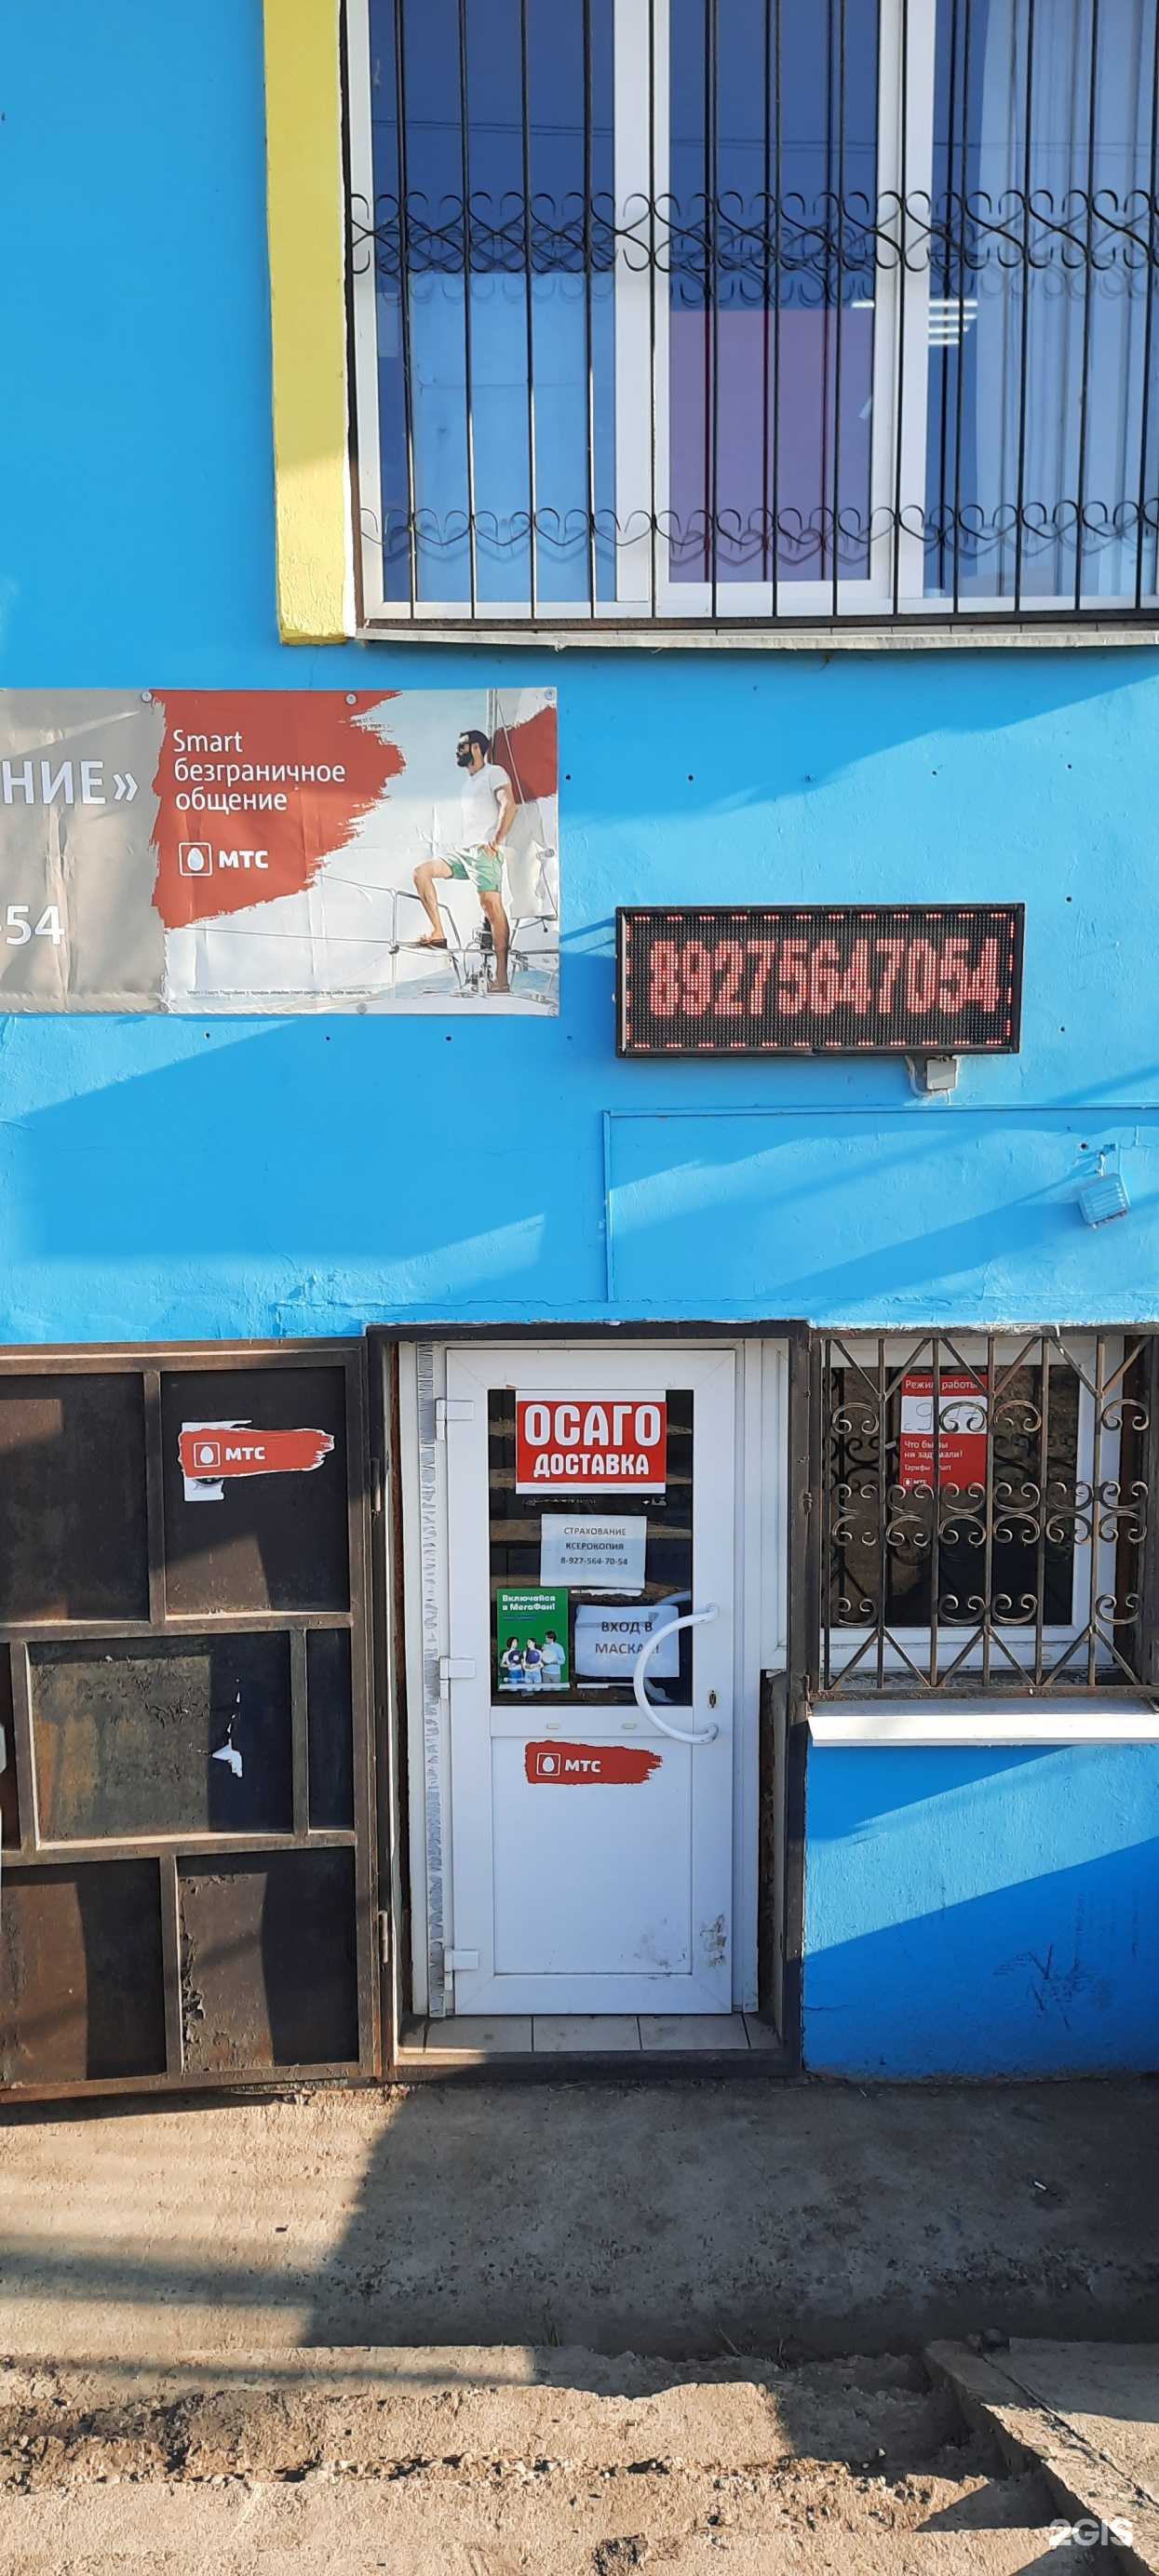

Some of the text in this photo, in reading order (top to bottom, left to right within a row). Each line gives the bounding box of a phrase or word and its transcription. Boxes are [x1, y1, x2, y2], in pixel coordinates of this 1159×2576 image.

[172, 730, 243, 753] Smart
[174, 758, 346, 787] безграничное
[175, 786, 288, 815] общение
[219, 850, 269, 869] МТС
[0, 905, 65, 946] 54
[651, 938, 1000, 1016] 89275647054
[904, 1379, 935, 1389] Режи
[524, 1404, 661, 1446] ОСАГО
[904, 1440, 920, 1448] Что
[225, 1446, 265, 1460] МТС
[918, 1449, 963, 1459] задмали!
[533, 1453, 650, 1478] ДОСТАВКА
[563, 1526, 627, 1536] СТРАХОВАНИЕ
[565, 1541, 625, 1551] КСЕРОКОПИЯ
[560, 1556, 628, 1565] 8-927-564-70-54
[502, 1594, 556, 1603] Включайся
[601, 1621, 654, 1634] ВХОД В
[595, 1643, 660, 1654] МАСКА!
[564, 1759, 601, 1773] МТС
